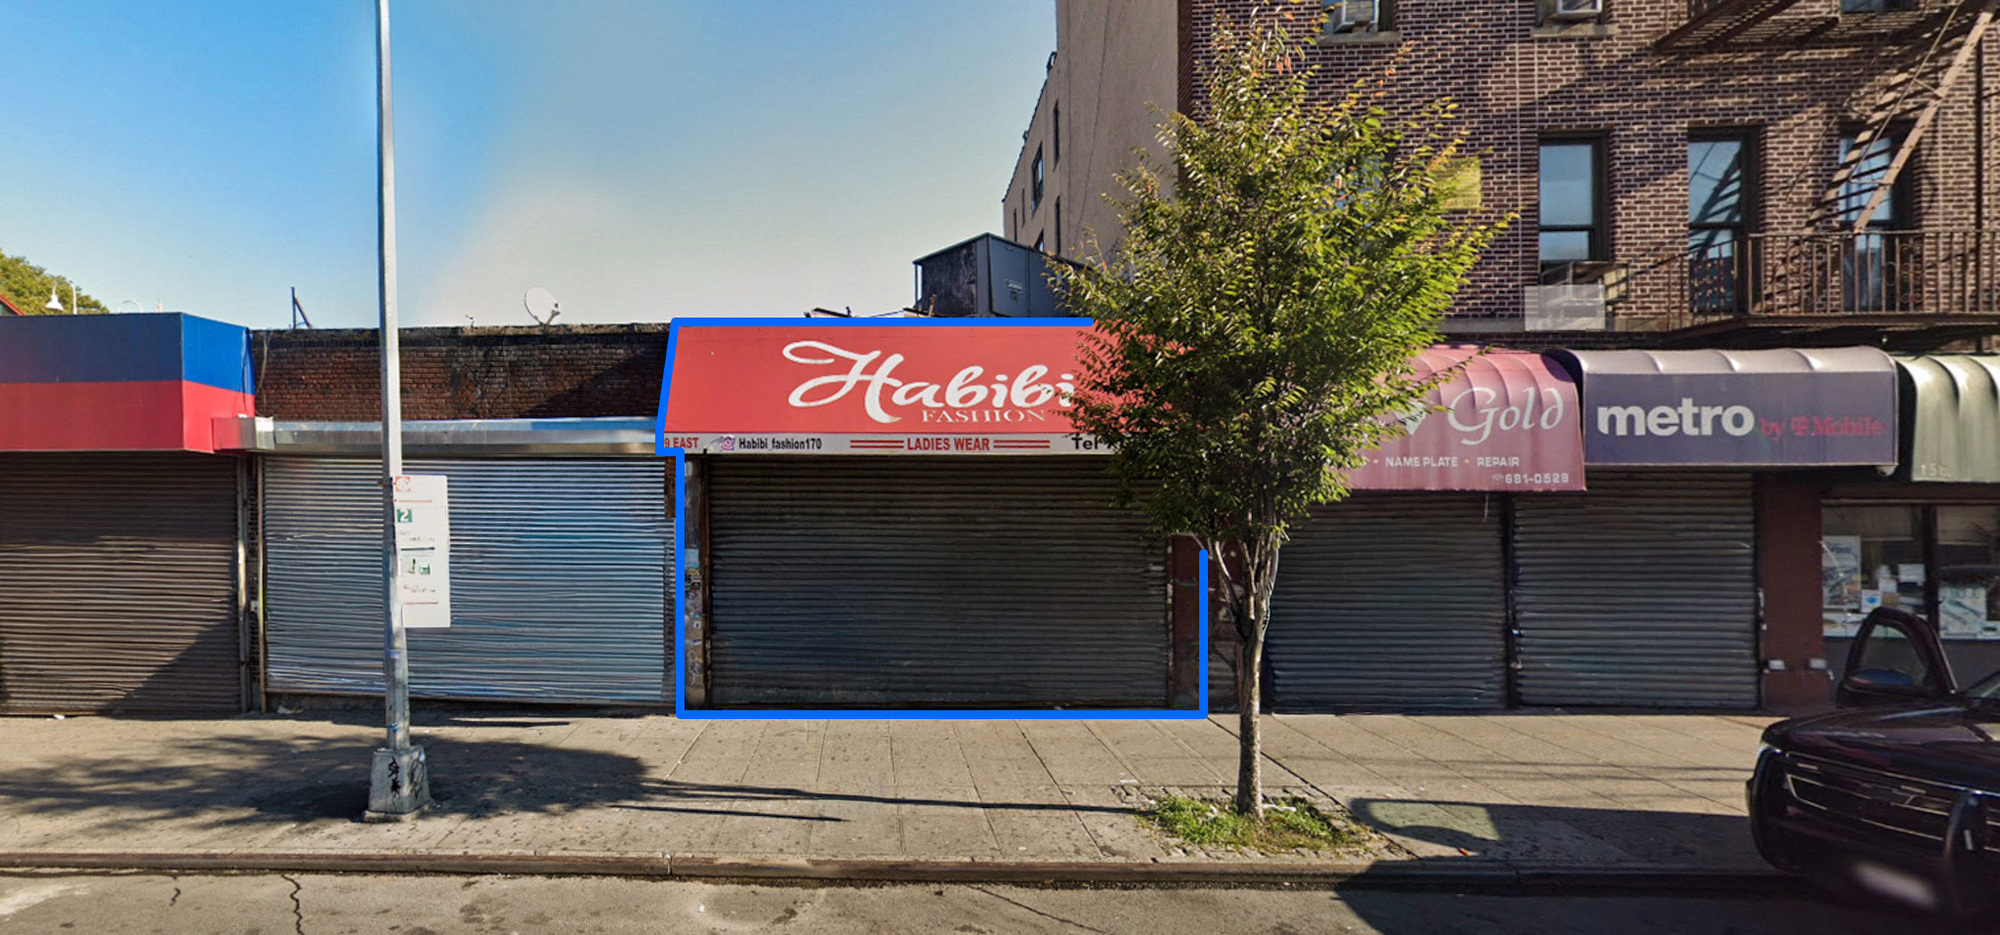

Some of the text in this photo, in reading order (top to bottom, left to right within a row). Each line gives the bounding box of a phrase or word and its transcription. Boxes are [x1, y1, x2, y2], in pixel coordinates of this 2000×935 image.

[782, 341, 1075, 423] Habibi
[922, 410, 1045, 422] FASHION
[1449, 386, 1565, 446] Gold
[1597, 398, 1755, 436] metro
[1760, 417, 1785, 439] by
[673, 437, 699, 449] EAST
[907, 437, 990, 450] LADIES WEAR
[1385, 456, 1458, 467] NAME PLATE
[1476, 456, 1520, 467] REPAIR
